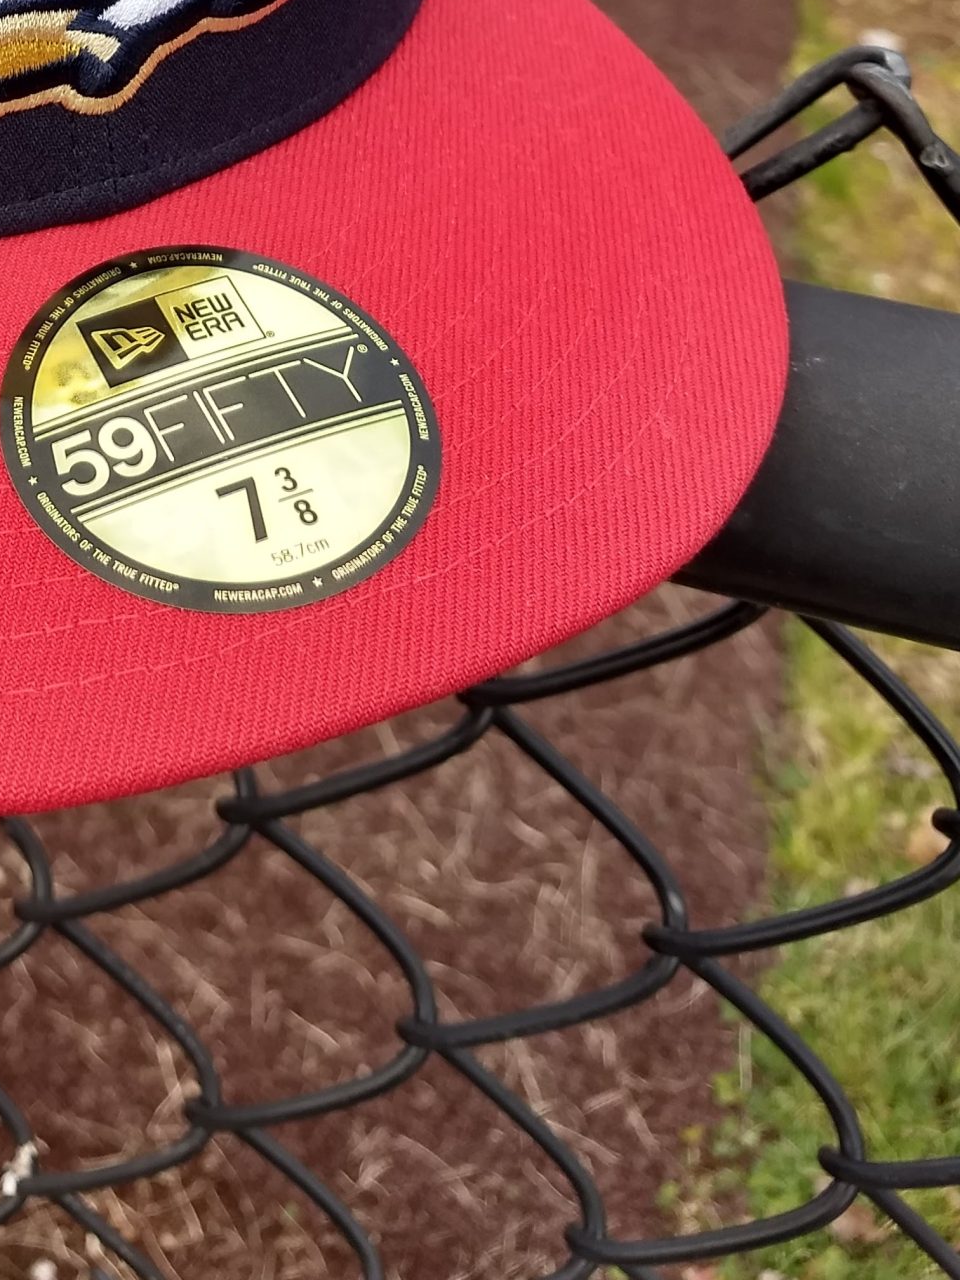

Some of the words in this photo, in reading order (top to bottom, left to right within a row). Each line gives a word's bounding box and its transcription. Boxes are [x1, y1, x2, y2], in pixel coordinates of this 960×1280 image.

[147, 252, 223, 265] NEWERACAP.COM
[73, 267, 122, 299] ORIGINATORS
[289, 275, 312, 292] TRUE
[313, 288, 331, 302] THE
[49, 307, 65, 321] THE
[63, 296, 75, 307] OF
[172, 293, 233, 324] NEW
[330, 300, 343, 310] OF
[38, 321, 54, 342] TRUE
[185, 311, 246, 342] ERA
[342, 308, 389, 351] ORIGINATORS
[399, 373, 430, 440] NEWERACAP.COM
[13, 396, 32, 467] NEWERACAP.COM
[215, 476, 268, 544] 7
[36, 492, 80, 541] ORIGINATORS
[79, 539, 93, 552] OF
[93, 548, 111, 566] THE
[112, 560, 137, 580] TRUE
[331, 540, 386, 580] ORIGINATORS
[382, 530, 396, 544] OF
[390, 516, 407, 535] THE
[401, 495, 419, 518] TRUE
[271, 538, 330, 566] 58.7cm
[214, 582, 304, 602] NEWERACAP.COM
